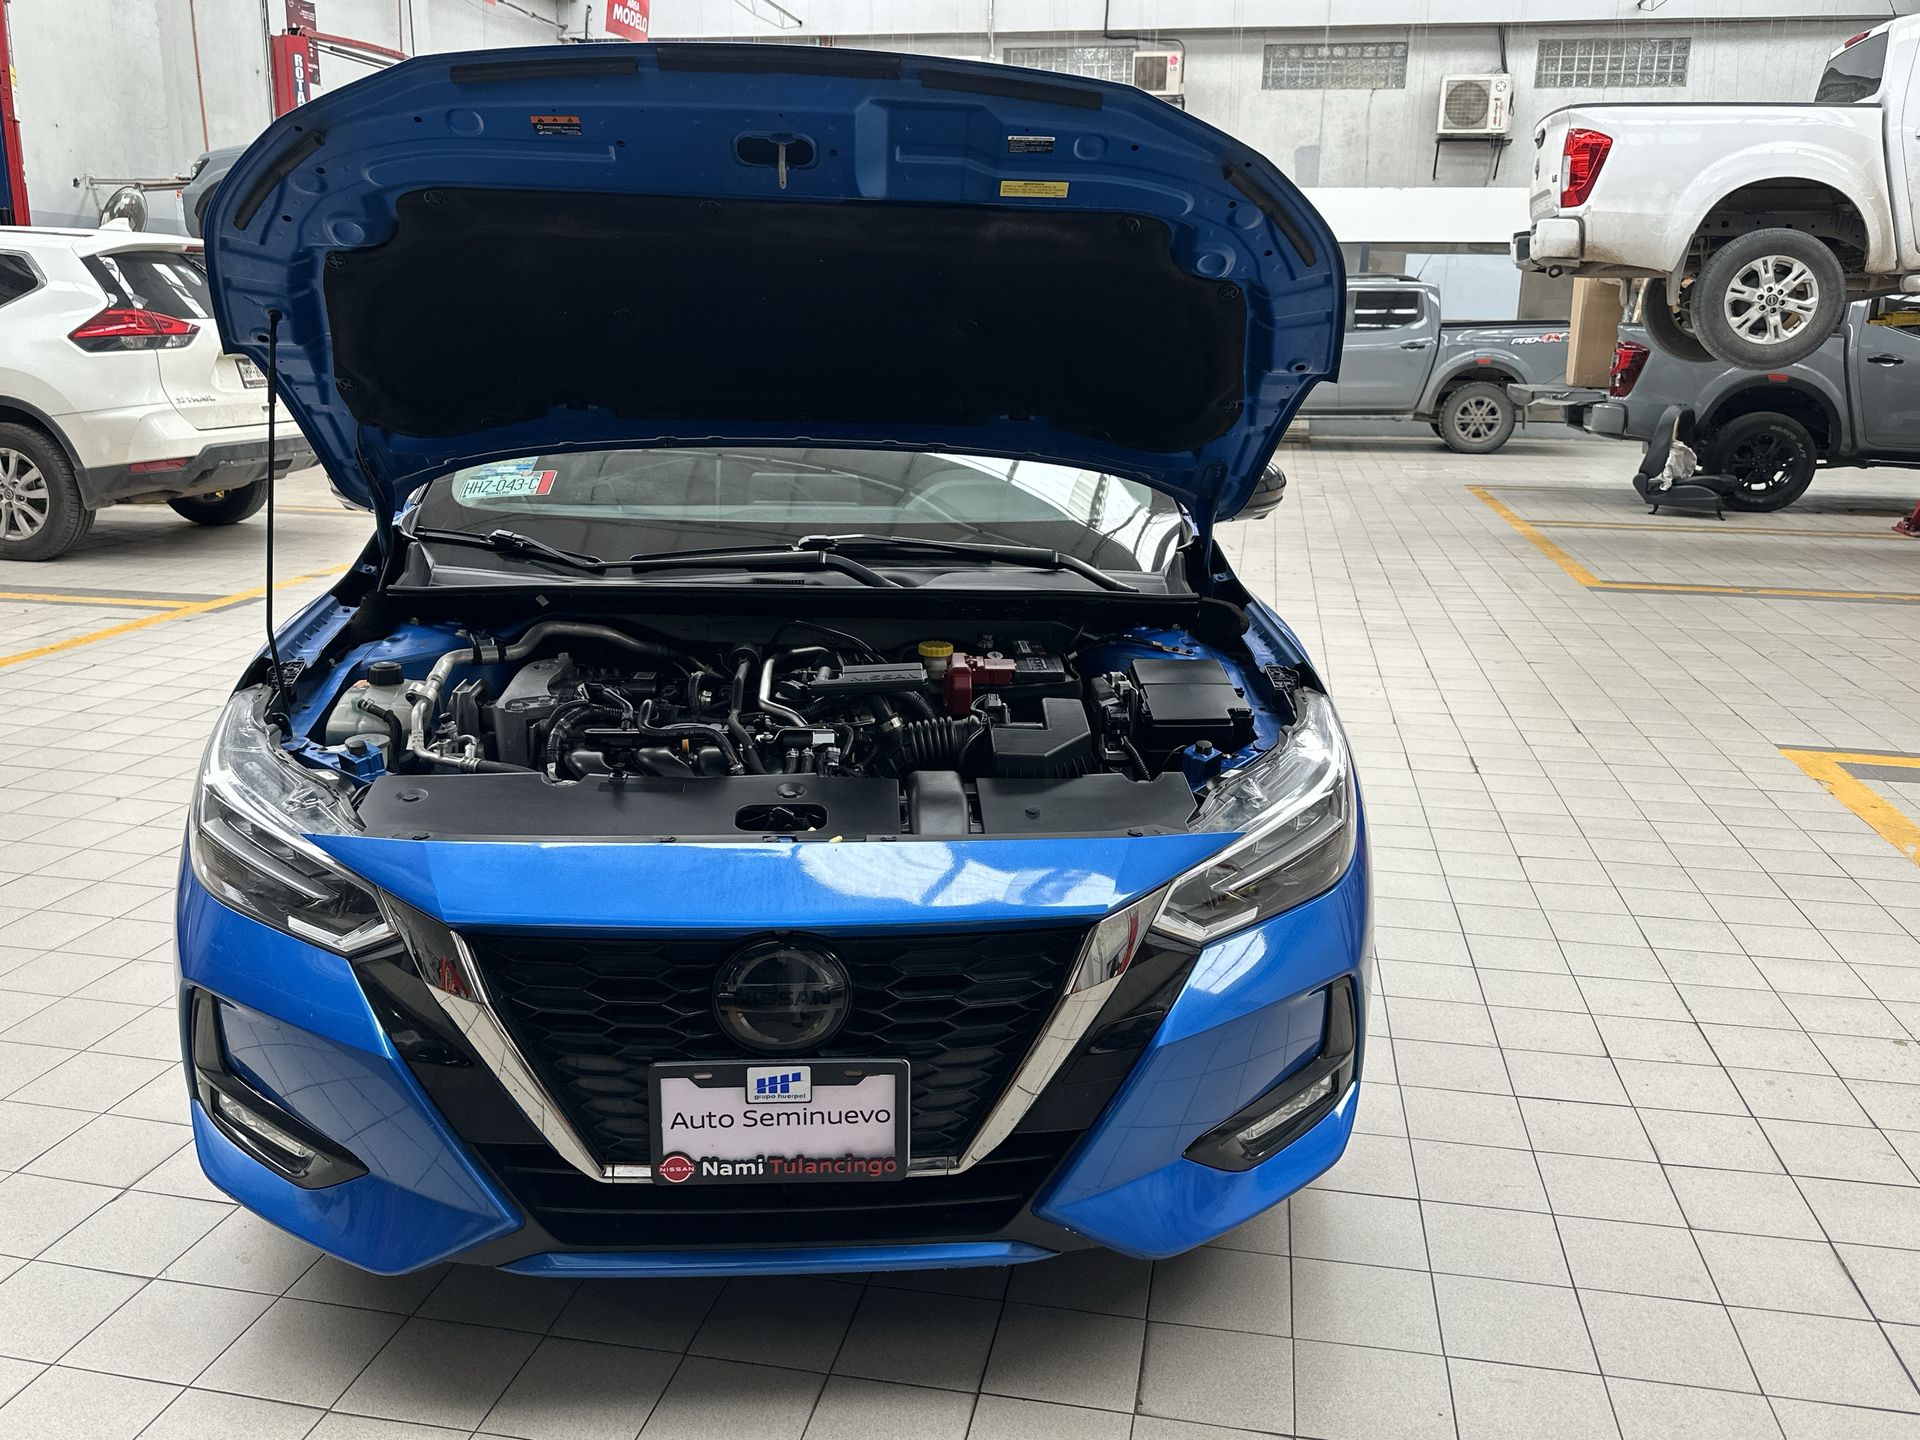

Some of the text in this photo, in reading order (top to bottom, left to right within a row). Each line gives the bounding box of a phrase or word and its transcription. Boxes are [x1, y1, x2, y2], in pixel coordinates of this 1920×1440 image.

[612, 3, 648, 33] MODELO
[293, 53, 307, 107] ROTA
[463, 477, 540, 495] HHZ-043-C
[850, 673, 920, 682] NISSAN
[670, 1107, 891, 1130] Auto Seminuevo
[658, 1165, 696, 1173] NISSAN
[702, 1157, 897, 1176] Nami Tulancingo
